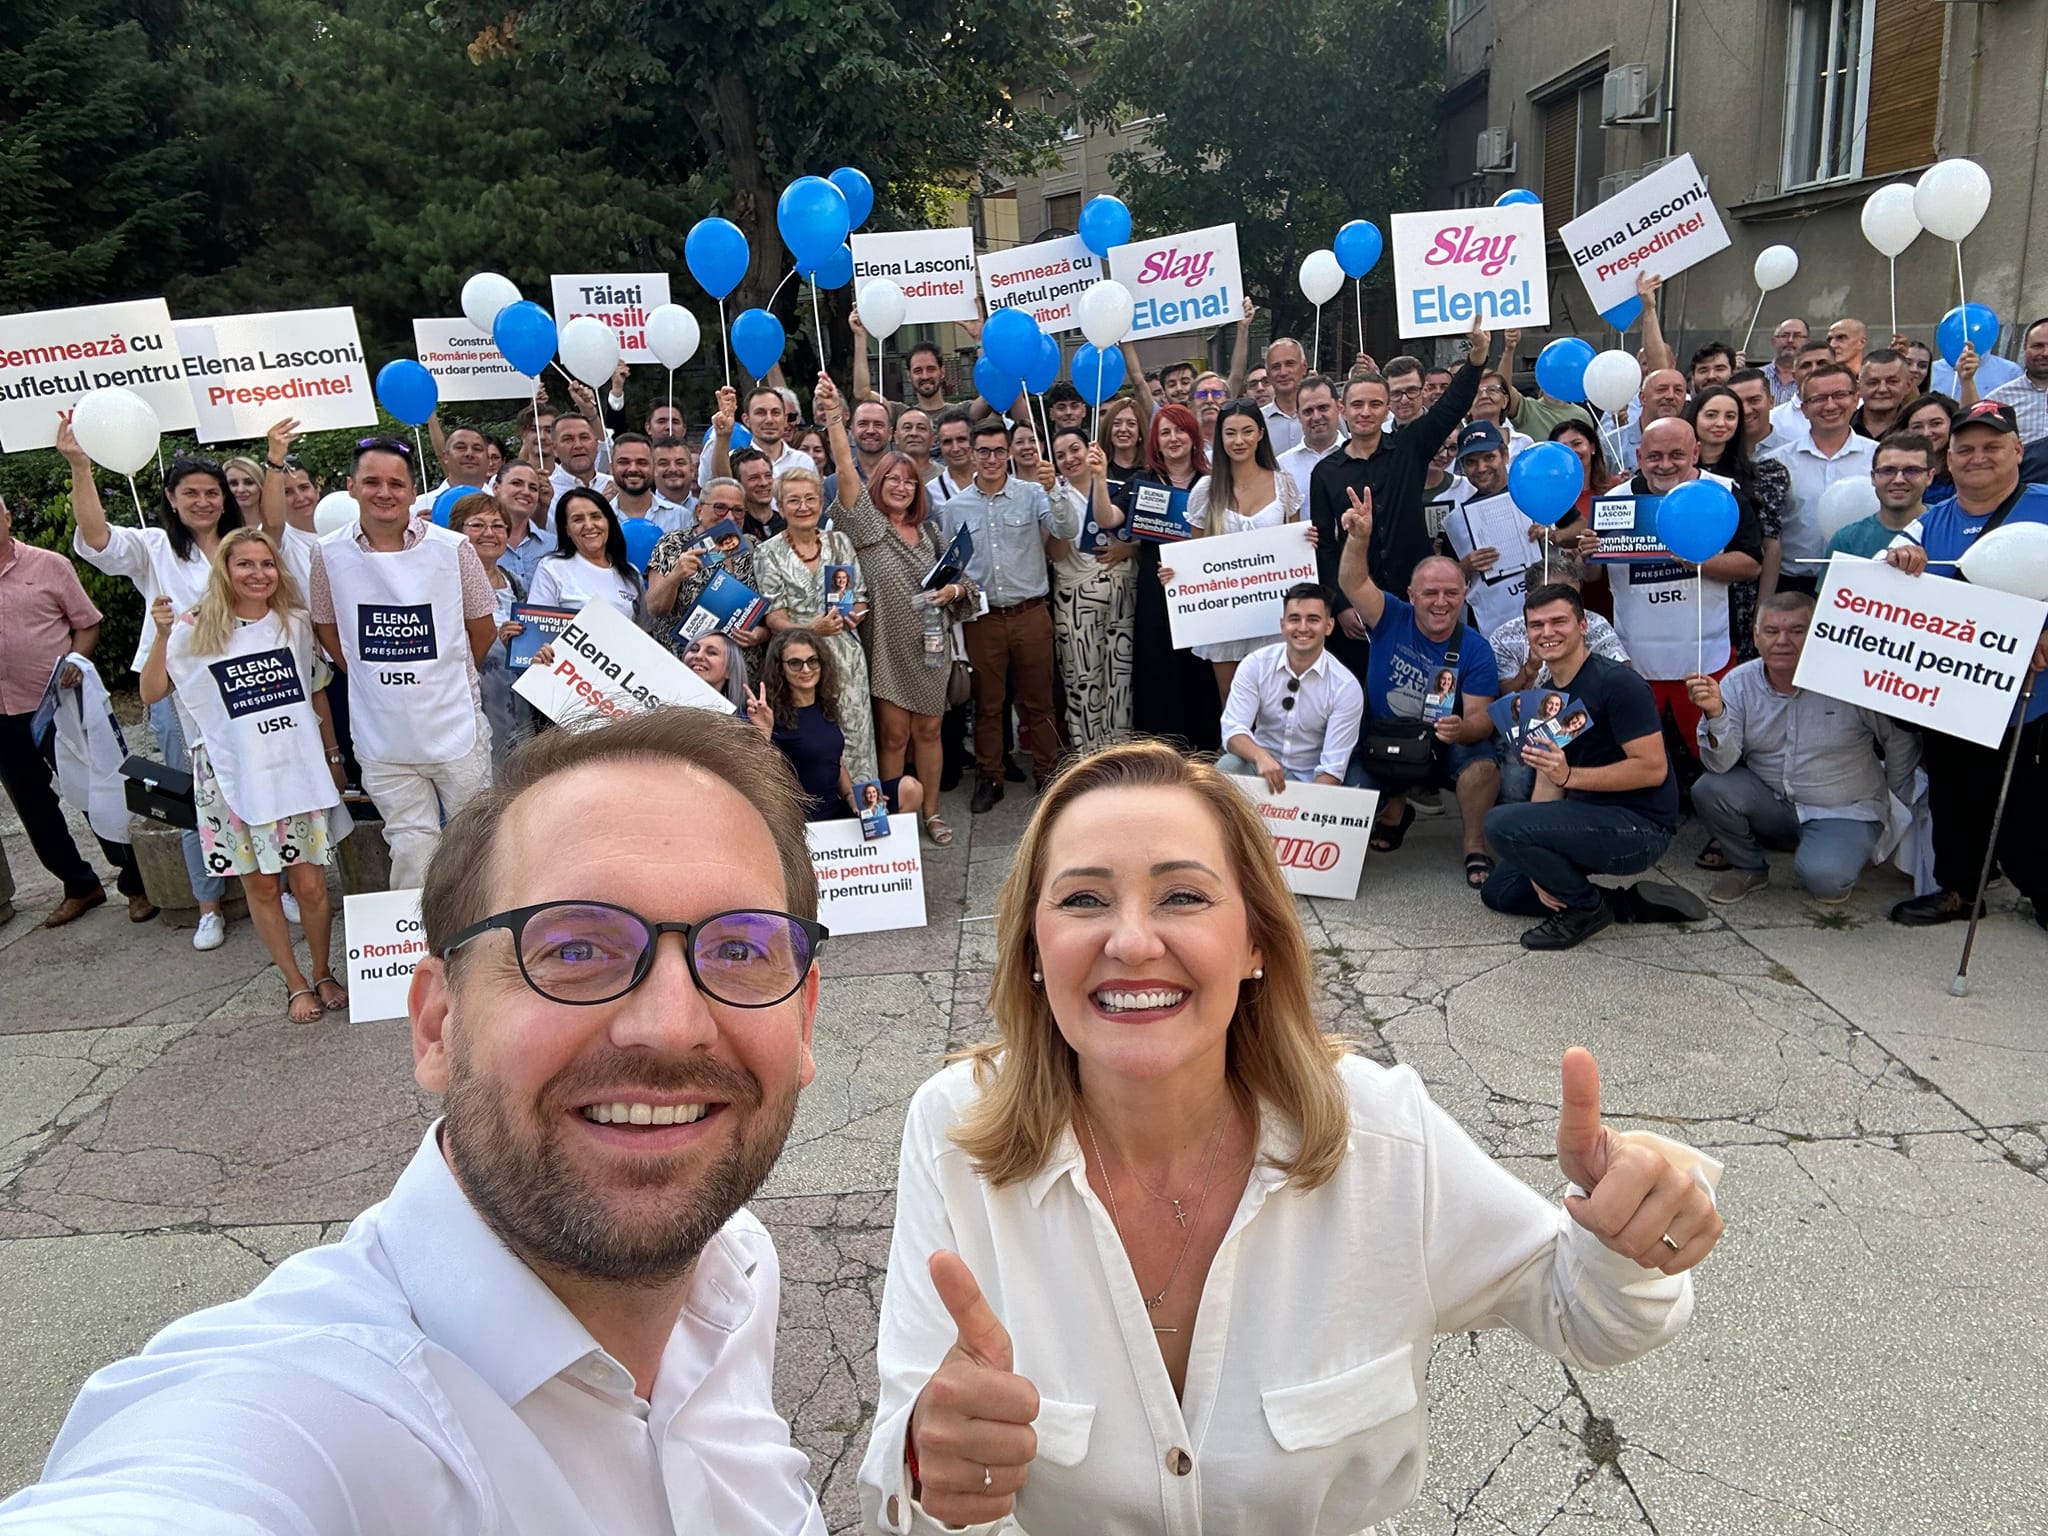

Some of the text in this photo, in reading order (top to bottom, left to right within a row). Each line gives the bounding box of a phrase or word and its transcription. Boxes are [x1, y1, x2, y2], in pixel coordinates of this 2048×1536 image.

[1574, 183, 1709, 266] Elena Lasconi,
[1424, 225, 1517, 276] Slay,
[1596, 212, 1705, 281] Președinte!
[855, 255, 975, 277] Elena Lasconi,
[990, 256, 1093, 288] Semnează cu
[1137, 247, 1215, 287] Slay,
[580, 285, 642, 309] Tăiați
[900, 280, 964, 298] edinte!
[989, 277, 1100, 311] sufletul pentr
[1131, 287, 1230, 331] Elena!
[1412, 280, 1531, 324] Elena!
[569, 308, 651, 327] nsiil
[0, 333, 163, 368] Semnează cu
[449, 336, 494, 347] Construi
[182, 342, 364, 378] Elena Lasconi,
[420, 351, 504, 362] o Românie pen
[430, 367, 443, 376] nu
[445, 365, 470, 375] doar
[472, 365, 508, 376] pentru
[0, 363, 180, 402] sufletul pentru
[208, 374, 354, 407] Președinte!
[1165, 527, 1192, 538] Român
[1599, 535, 1645, 544] emnătura
[1598, 542, 1633, 552] chimbă
[1203, 553, 1274, 574] Construim
[1168, 564, 1315, 597] o Românie pentru toți,
[1508, 583, 1526, 596] US
[1178, 603, 1198, 614] nu
[1199, 597, 1229, 611] doar
[1232, 590, 1278, 609] pentru
[1649, 590, 1686, 604] USR.
[373, 612, 420, 624] ELENA
[517, 614, 560, 625] România.
[1834, 588, 2018, 654] Semnează cu
[365, 624, 428, 637] LASCONI
[365, 645, 429, 656] PREȘEDINTE
[560, 623, 622, 680] Elena
[1814, 621, 2016, 692] sufletul pentru
[226, 657, 282, 678] ELENA
[380, 672, 421, 685] USR.
[223, 667, 294, 692] LASCONI
[1863, 670, 1941, 707] viitor!
[232, 687, 299, 710] PREȘEDINTE
[257, 716, 298, 734] USR.
[1301, 811, 1309, 821] e
[1312, 811, 1337, 827] așa
[1340, 816, 1370, 828] mai
[811, 844, 877, 861] onstruim
[1273, 836, 1340, 871] ULO
[840, 863, 889, 880] pentru
[892, 858, 919, 874] toți,
[830, 884, 879, 901] pentru
[882, 878, 912, 892] unii!
[349, 940, 428, 960] o Români
[361, 962, 417, 980] nu doa
